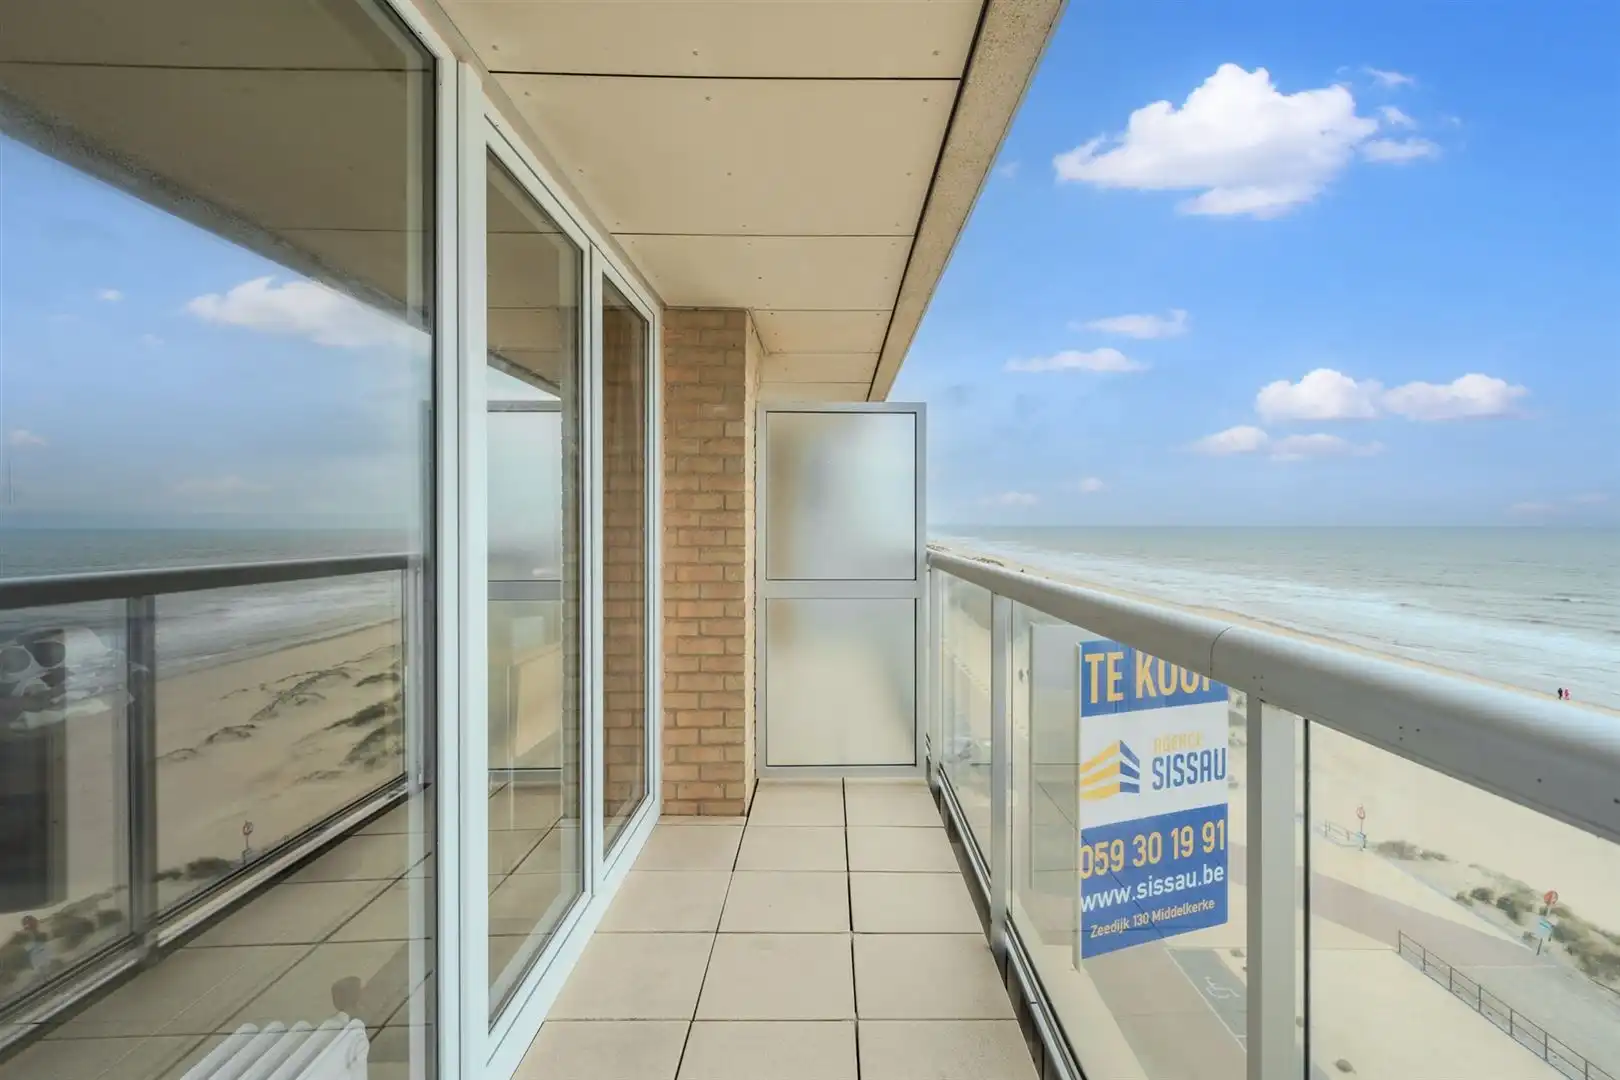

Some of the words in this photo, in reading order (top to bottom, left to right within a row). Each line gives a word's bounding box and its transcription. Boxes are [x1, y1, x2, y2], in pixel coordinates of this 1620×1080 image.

[1084, 651, 1124, 704] TE
[1135, 649, 1211, 699] KOO
[1151, 747, 1226, 791] SISSAU
[1079, 839, 1125, 879] 059
[1132, 831, 1162, 867] 30
[1171, 825, 1194, 860] 19
[1202, 819, 1225, 853] 91
[1080, 864, 1225, 913] www.sissau.be
[1090, 917, 1130, 938] Zeedijk
[1132, 912, 1150, 927] 130
[1151, 899, 1216, 922] Middelkerke
